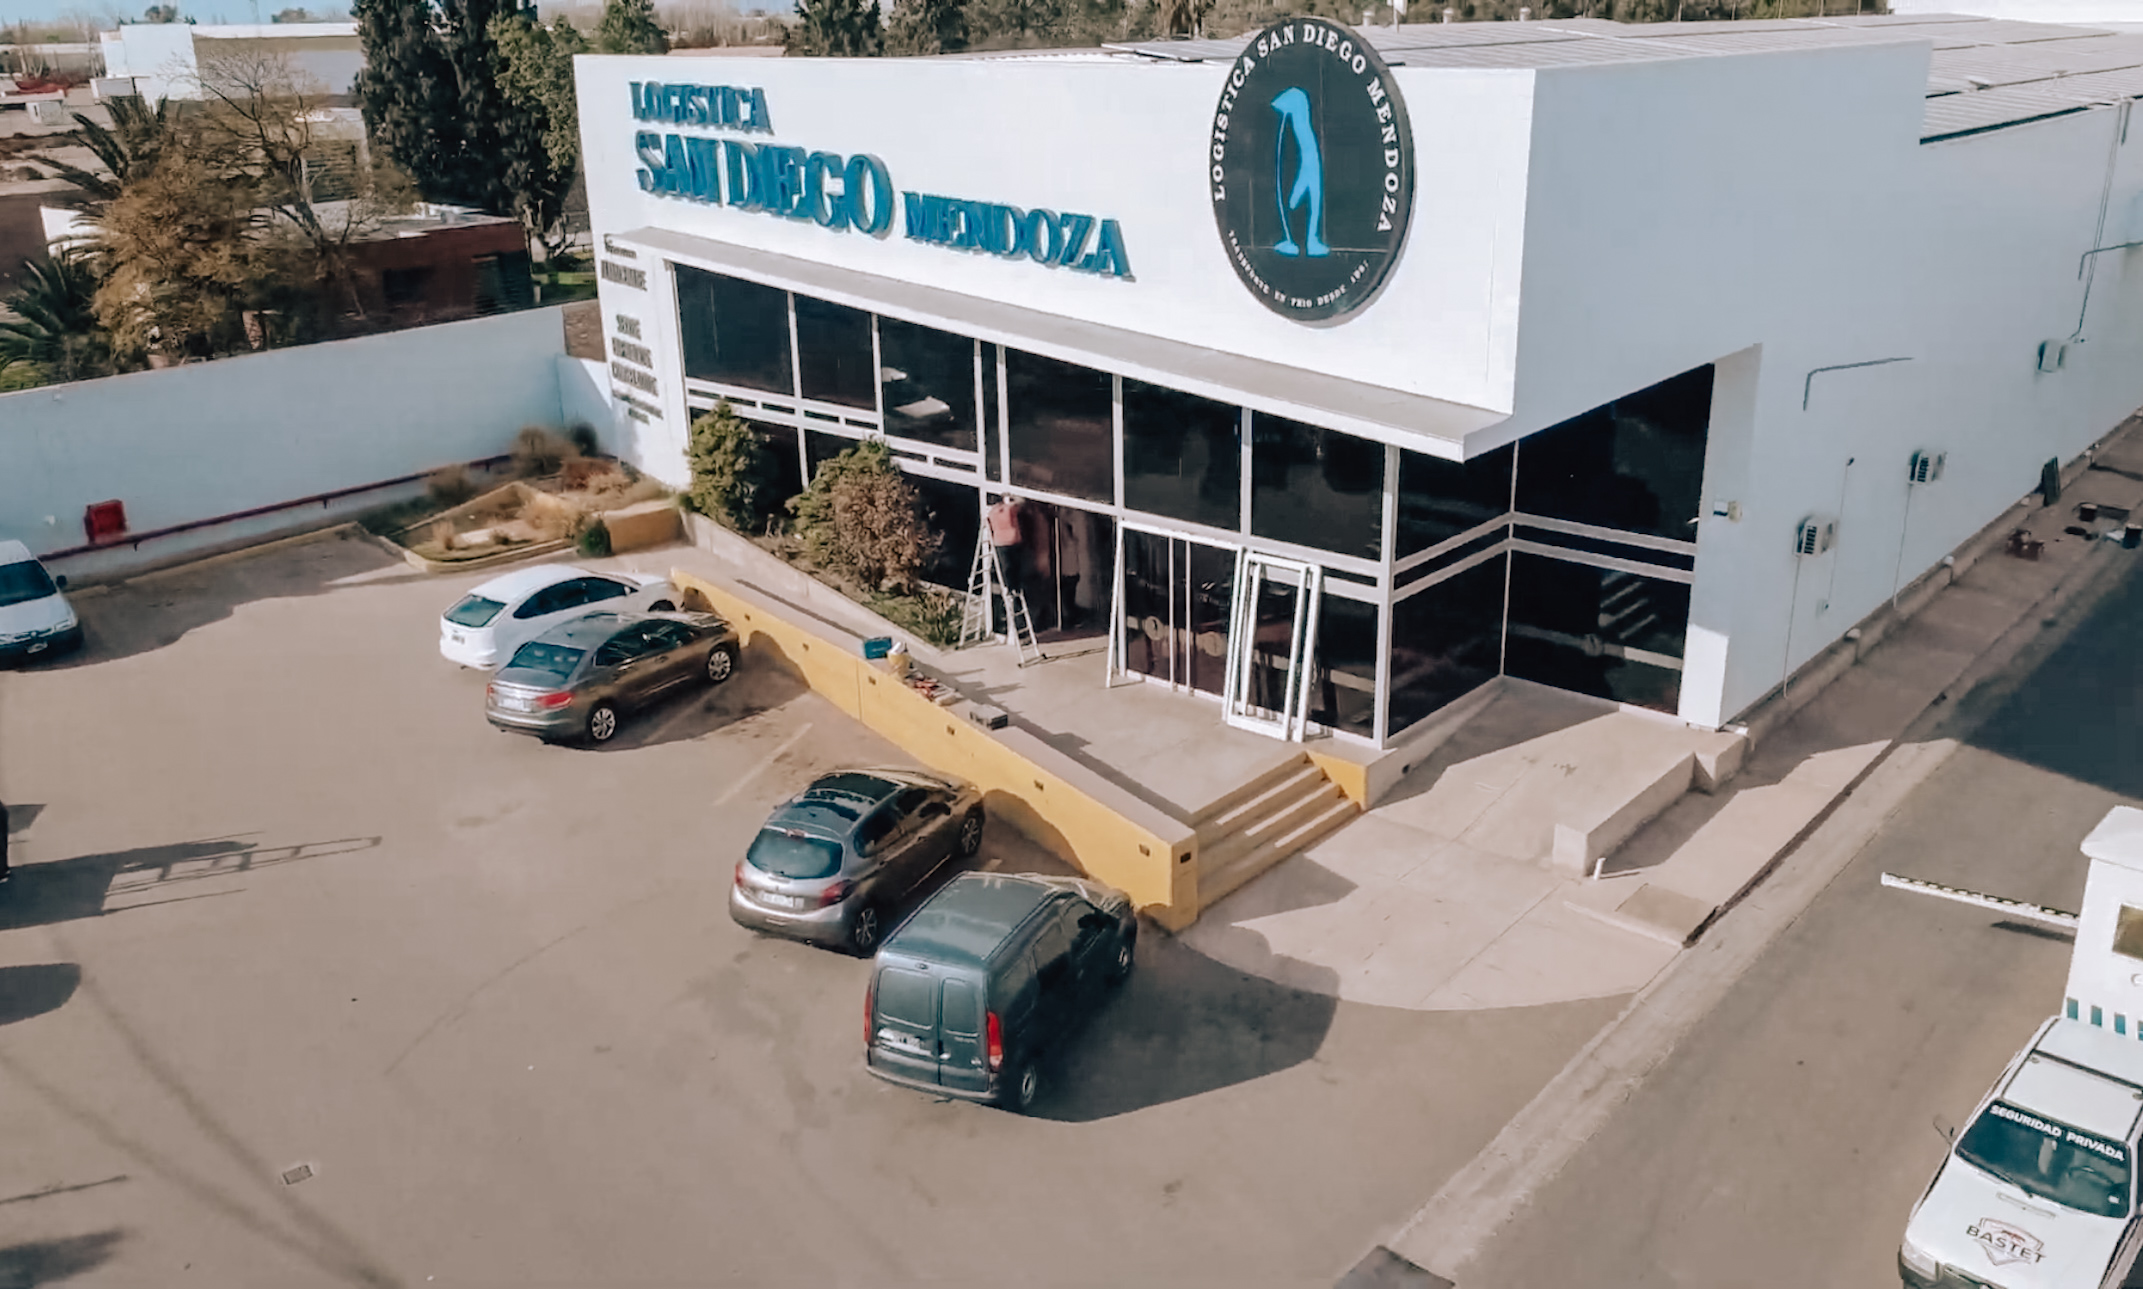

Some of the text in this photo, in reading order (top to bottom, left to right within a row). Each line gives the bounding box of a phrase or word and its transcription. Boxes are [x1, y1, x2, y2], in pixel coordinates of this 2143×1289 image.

[629, 81, 774, 136] LOGISTICA
[1210, 23, 1398, 232] LOGISTICA SAN DIEGO MENDOZA
[634, 129, 1136, 283] SAN DIEGO MENDOZA
[1989, 1104, 2125, 1162] SEGURIDAD PRIVADA
[1965, 1225, 2046, 1263] BASTET
